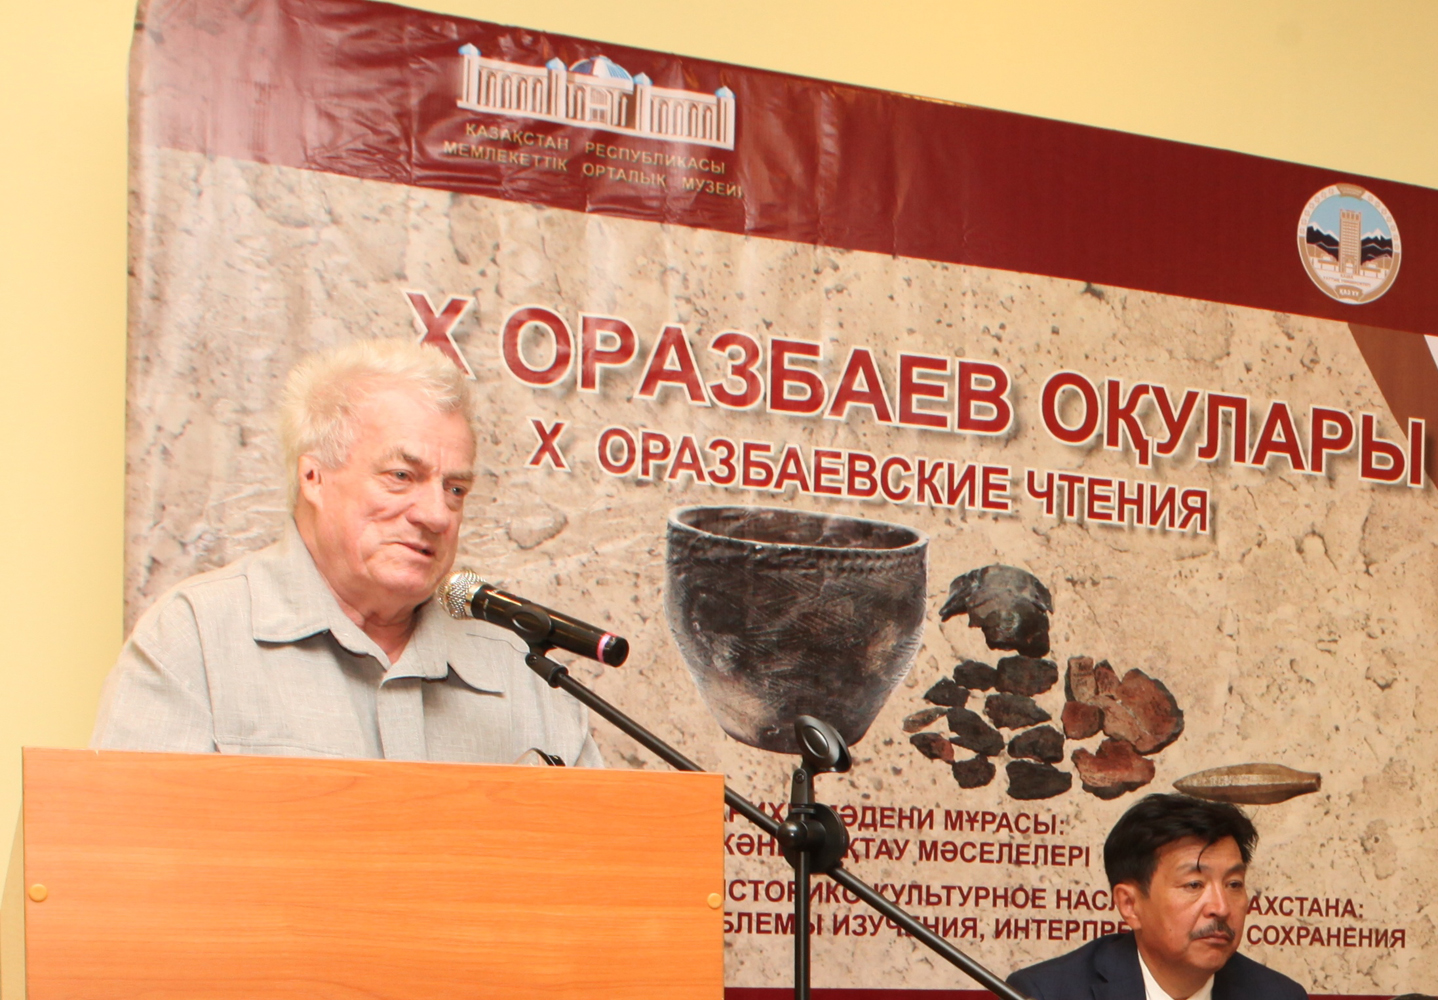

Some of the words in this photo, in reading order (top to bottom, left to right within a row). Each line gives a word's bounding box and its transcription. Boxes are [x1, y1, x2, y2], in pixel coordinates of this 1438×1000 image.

[442, 139, 569, 172] МЕМЛЕКЕТТІК
[582, 162, 667, 188] ОРТАЛЫҚ
[681, 176, 744, 198] МУЗЕЙІ
[465, 122, 570, 152] ҚАЗАҚСТАН
[585, 141, 726, 175] РЕСПУБЛИКАСЫ
[500, 304, 1013, 434] ОРАЗБАЕВ
[1040, 369, 1425, 488] ОҚУЛАРЫ
[598, 425, 1012, 512] ОРАЗБАЕВСКИЕ
[1025, 468, 1211, 534] ЧТЕНИЯ
[943, 808, 1066, 836] МҰРАСЫ:
[918, 840, 1091, 868] МӘСЕЛЕЛЕРІ
[1245, 924, 1407, 949] СОХРАНЕНИЯ
